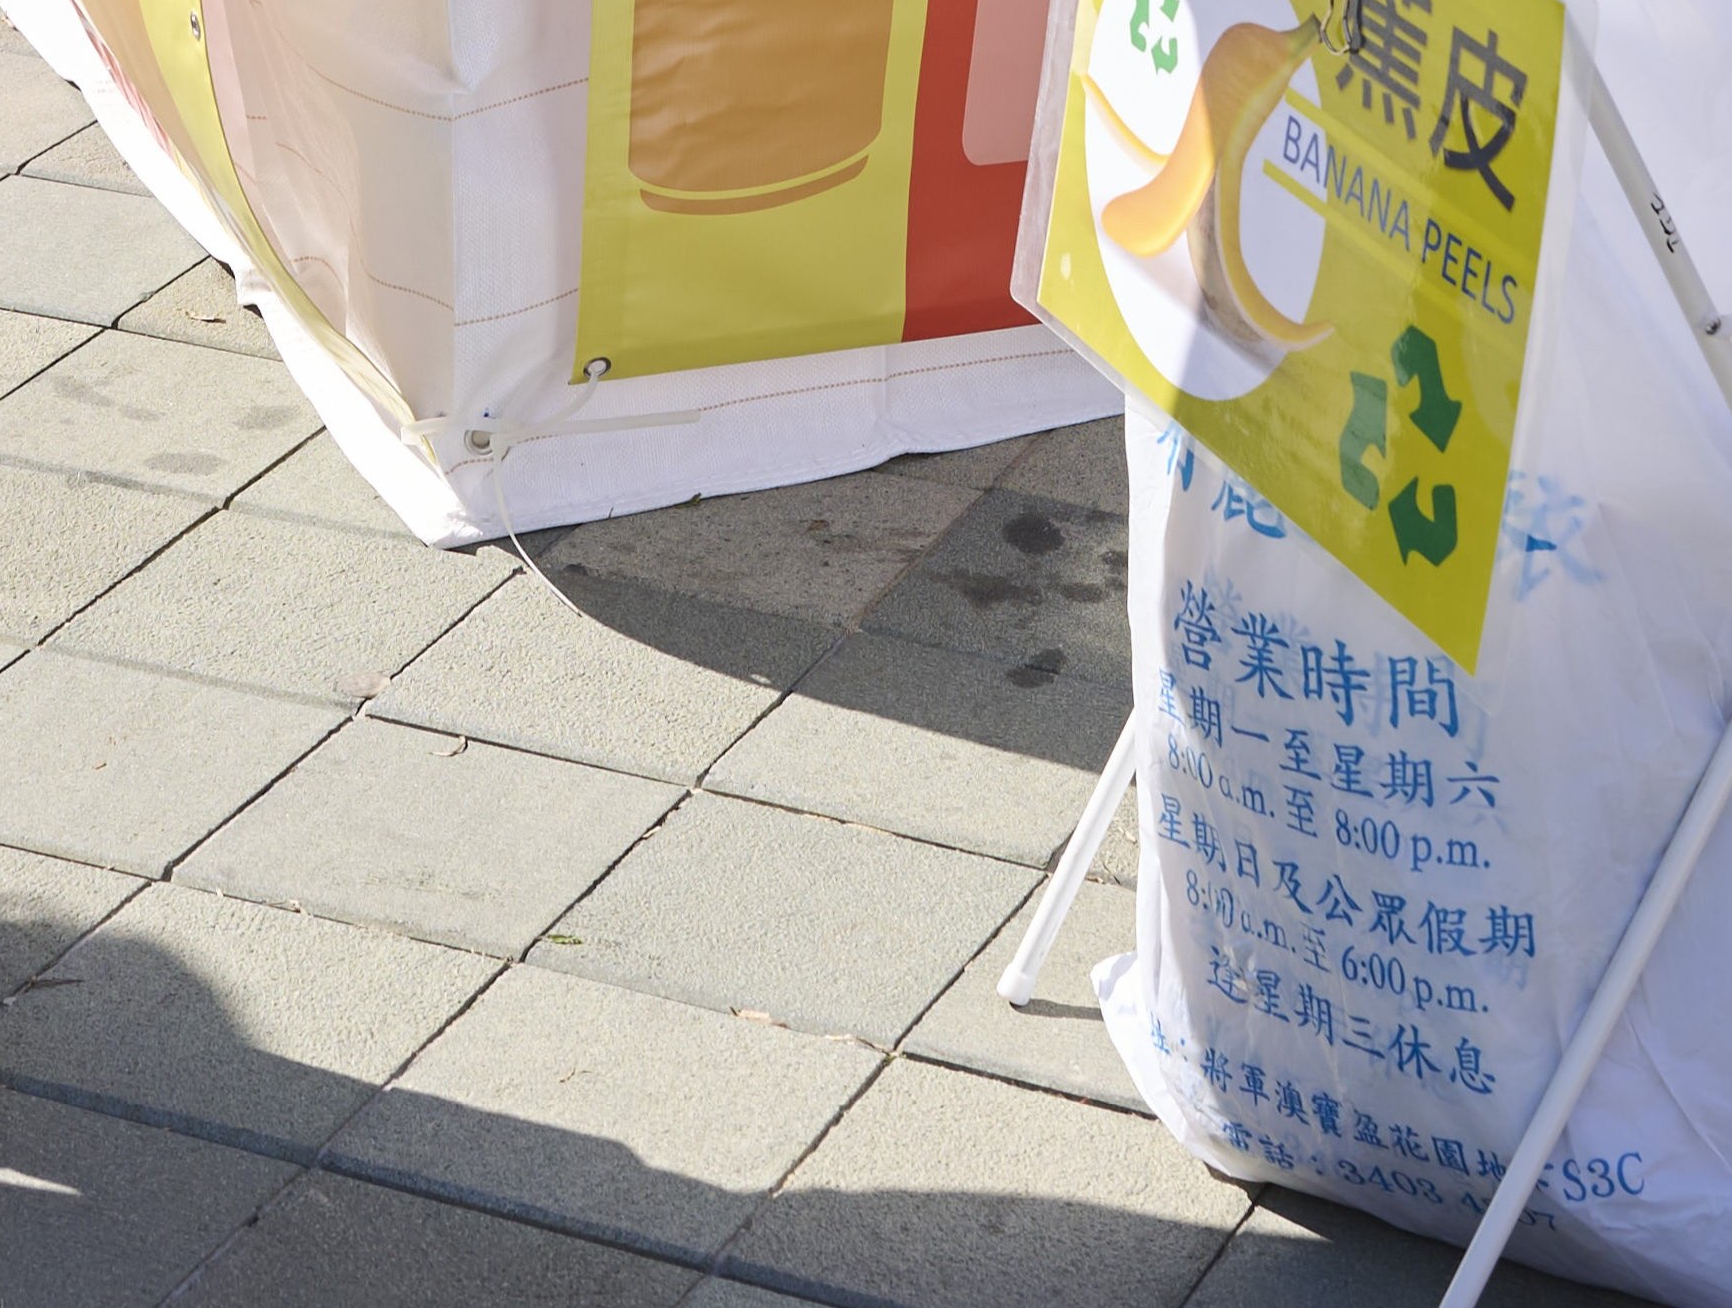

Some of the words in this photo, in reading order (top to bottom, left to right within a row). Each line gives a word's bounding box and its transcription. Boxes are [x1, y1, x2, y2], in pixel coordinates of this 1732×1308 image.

[1281, 115, 1411, 252] BANANA
[1421, 217, 1519, 325] PEELS
[1173, 579, 1460, 739] 營業時間
[1157, 666, 1501, 809] 星期一至星期六
[1168, 733, 1213, 789] 8:00
[1218, 771, 1276, 819] a.m.
[1282, 783, 1318, 838] 至
[1335, 808, 1401, 860] 8:00
[1411, 832, 1492, 873] p.m.
[1157, 793, 1536, 959] 星期日及公眾假期
[1301, 922, 1331, 974] 至
[1341, 946, 1406, 996] 6:00
[1413, 975, 1490, 1014] p.m.
